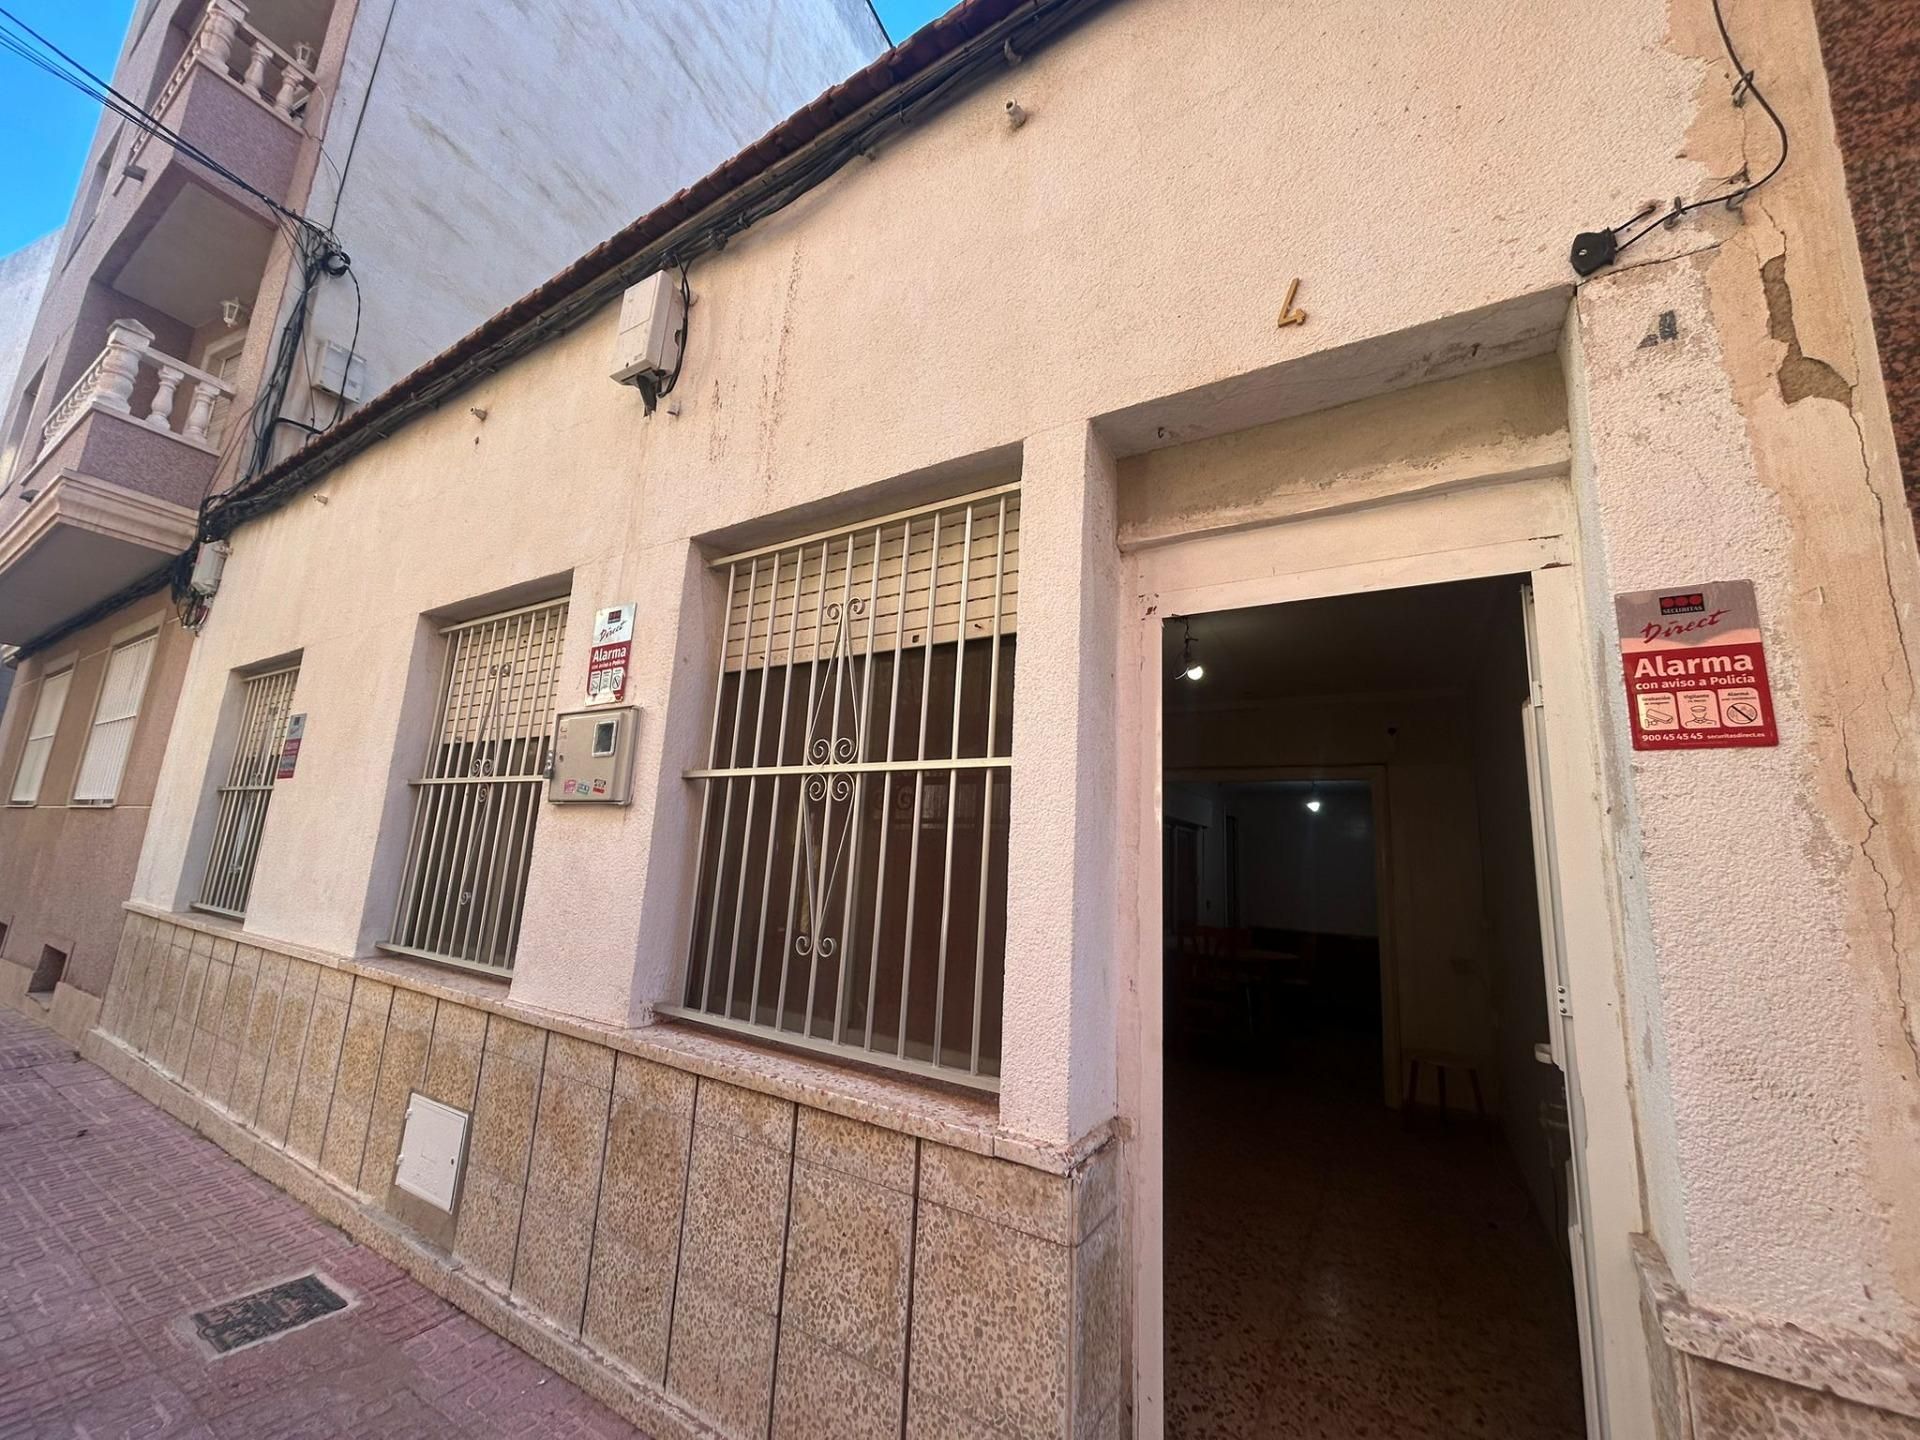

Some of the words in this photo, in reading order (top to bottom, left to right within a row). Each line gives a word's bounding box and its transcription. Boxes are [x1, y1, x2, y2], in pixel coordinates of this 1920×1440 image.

[1663, 605, 1703, 614] SECURITAS
[1640, 609, 1732, 644] Direct
[592, 647, 626, 663] Alarma
[1634, 654, 1753, 678] Alarma
[1635, 681, 1659, 690] con
[1661, 678, 1696, 689] aviso
[1710, 674, 1756, 685] Policía
[1642, 733, 1661, 741] 900
[1663, 733, 1675, 741] 45
[1690, 732, 1703, 740] 45
